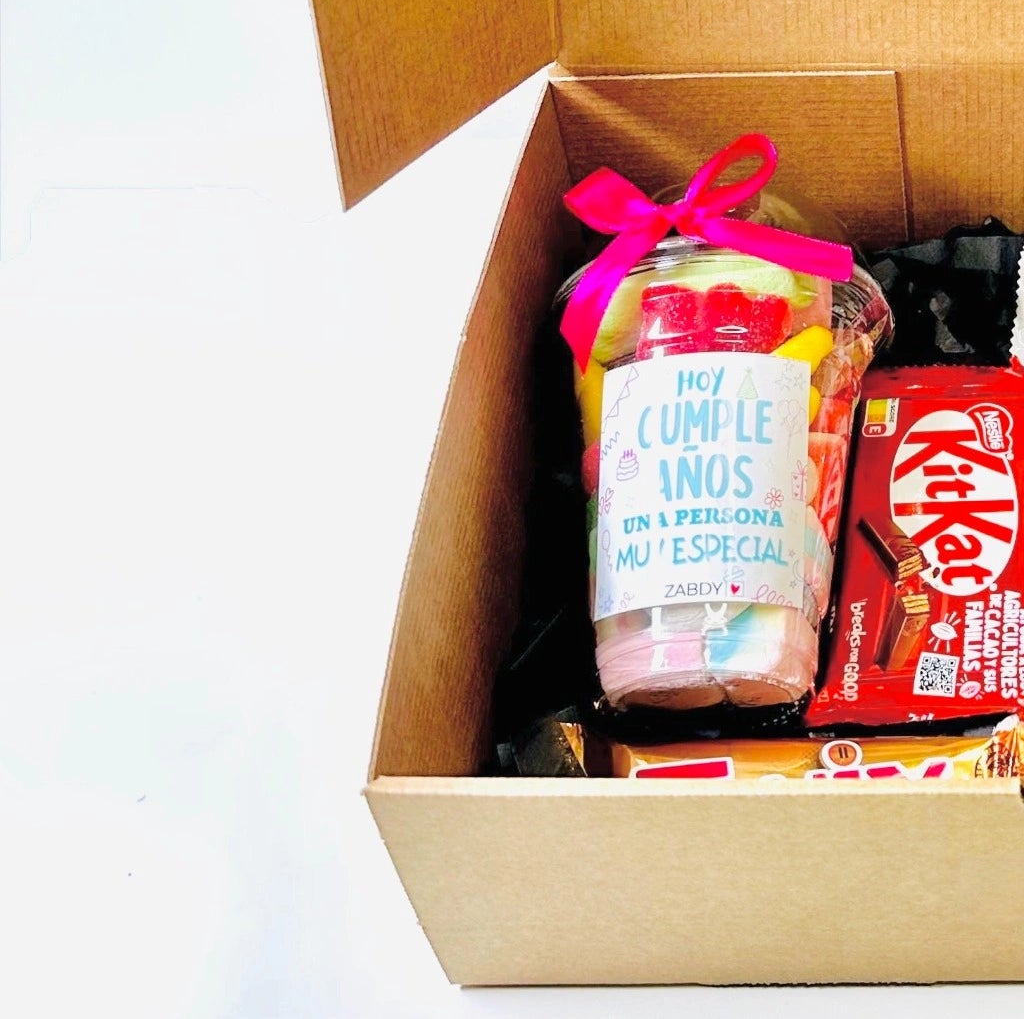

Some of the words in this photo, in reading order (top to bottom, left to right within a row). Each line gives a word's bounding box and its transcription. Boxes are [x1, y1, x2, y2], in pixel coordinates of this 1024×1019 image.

[677, 366, 725, 397] HOY
[638, 399, 773, 449] CUMPLE
[674, 507, 784, 528] PERSONA
[673, 534, 788, 566] ESPECIAL
[664, 582, 723, 598] ZABDY
[988, 593, 1002, 609] DE
[849, 601, 867, 648] breaks
[962, 601, 984, 672] FAMILIAS
[983, 608, 1001, 658] CACAO
[1001, 590, 1021, 699] AGRICULTORES
[984, 659, 997, 667] Y
[984, 669, 997, 693] SUS
